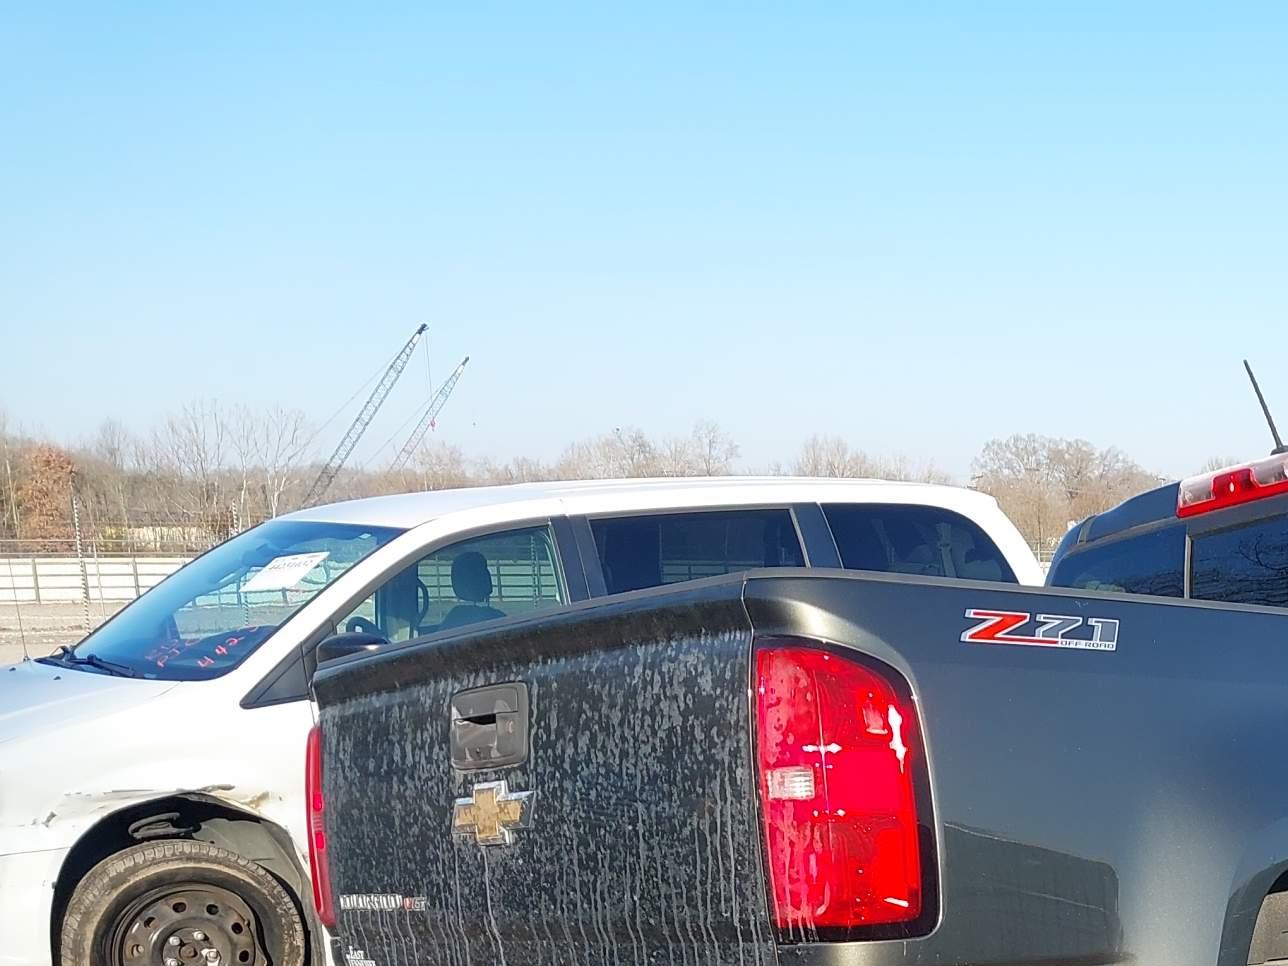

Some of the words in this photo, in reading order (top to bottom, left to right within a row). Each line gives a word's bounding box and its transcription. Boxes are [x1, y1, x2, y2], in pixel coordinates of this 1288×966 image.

[960, 609, 1120, 649] Z71
[1059, 640, 1081, 648] OFF
[1084, 641, 1115, 650] ROAD
